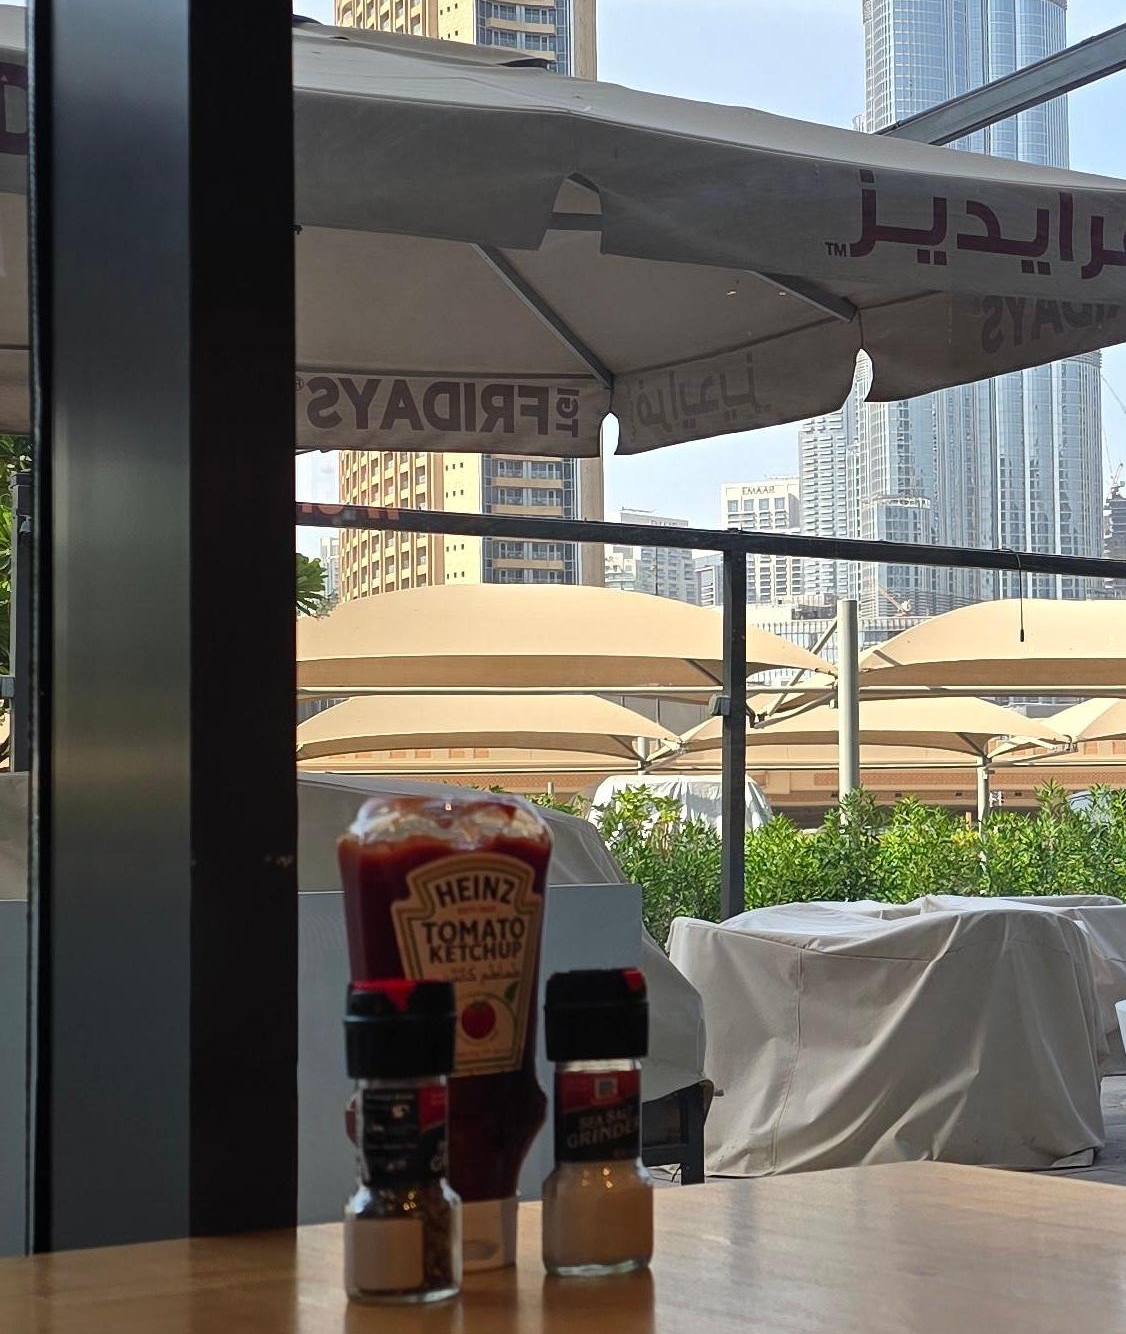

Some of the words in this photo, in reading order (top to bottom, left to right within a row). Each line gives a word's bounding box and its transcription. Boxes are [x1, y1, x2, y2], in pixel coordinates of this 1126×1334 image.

[742, 485, 775, 496] EMAAR
[433, 874, 516, 907] HEINZ
[422, 917, 526, 945] TOMATO
[429, 941, 523, 964] KETCHUP
